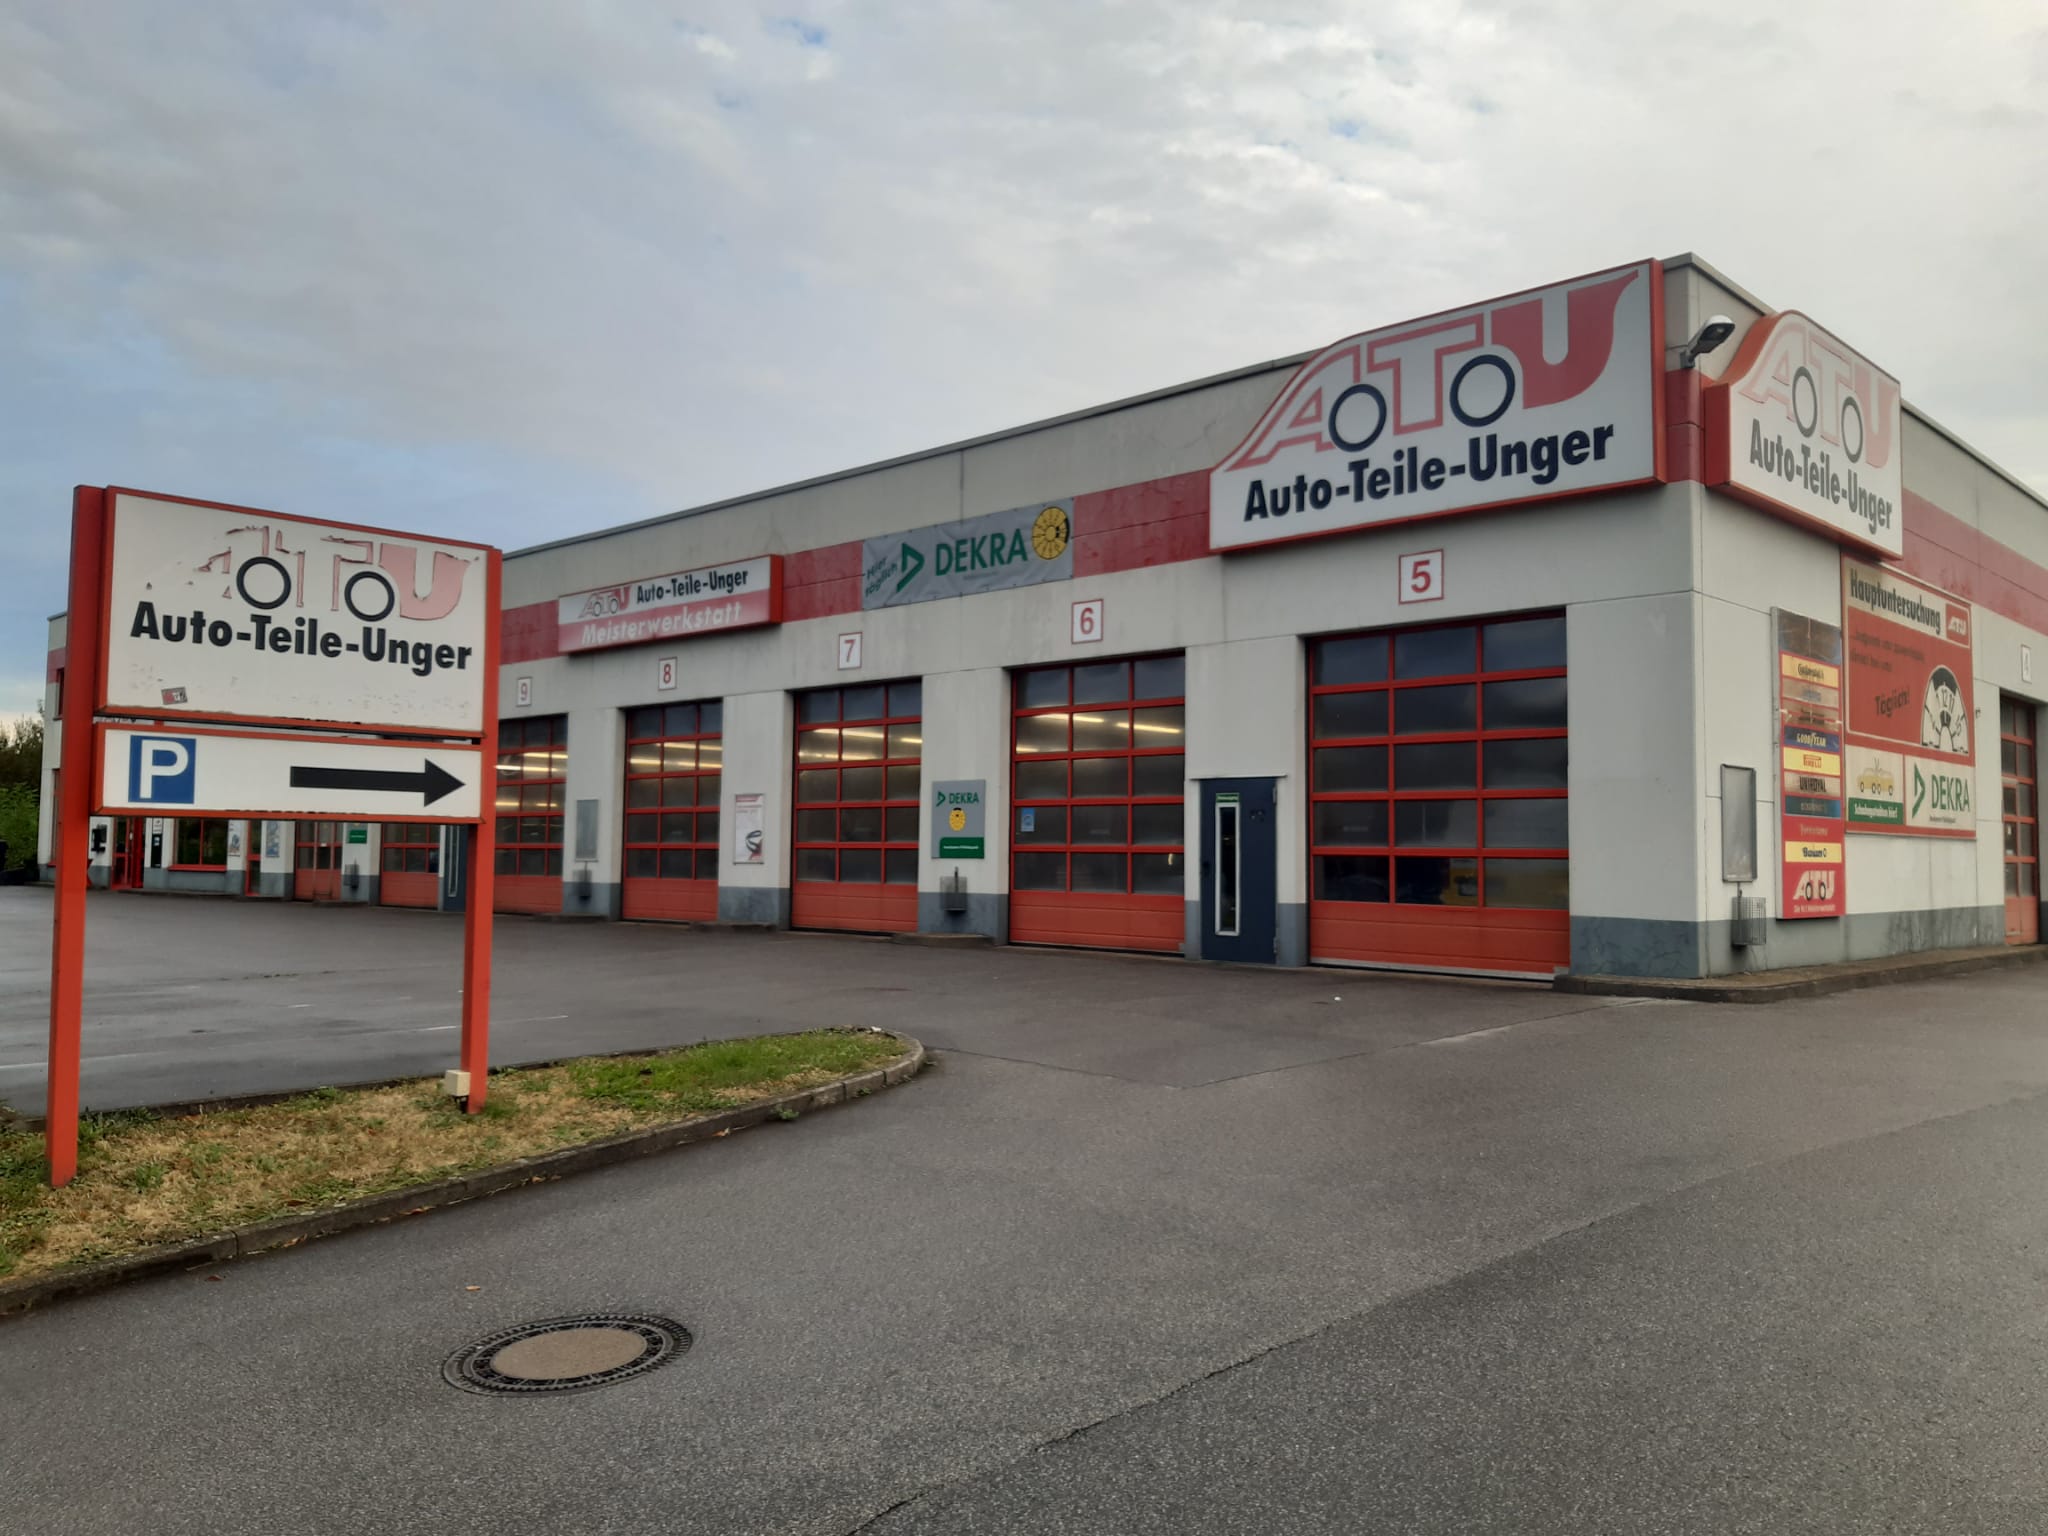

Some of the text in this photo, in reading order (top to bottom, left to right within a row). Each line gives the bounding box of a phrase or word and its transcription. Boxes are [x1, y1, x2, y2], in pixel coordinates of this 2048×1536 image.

[1224, 269, 1639, 473] ATU
[1243, 423, 1615, 522] Auto-Teile-Unger
[1749, 418, 1893, 536] Auto-Teile-Unger
[935, 528, 1028, 576] DEKRA
[636, 568, 749, 604] Auto-Teile-Unger
[1410, 559, 1432, 594] 5
[1079, 607, 1095, 635] 6
[1850, 568, 1941, 635] Hauptuntersuchung
[131, 600, 473, 677] Auto-Teile-Unger
[580, 601, 742, 646] Meisterwerkstatt
[843, 639, 856, 663] 7
[662, 663, 672, 685] 8
[139, 739, 190, 800] P
[948, 792, 980, 805] DEKRA
[1931, 774, 1971, 813] DEKRA
[1792, 869, 1836, 901] ATU
